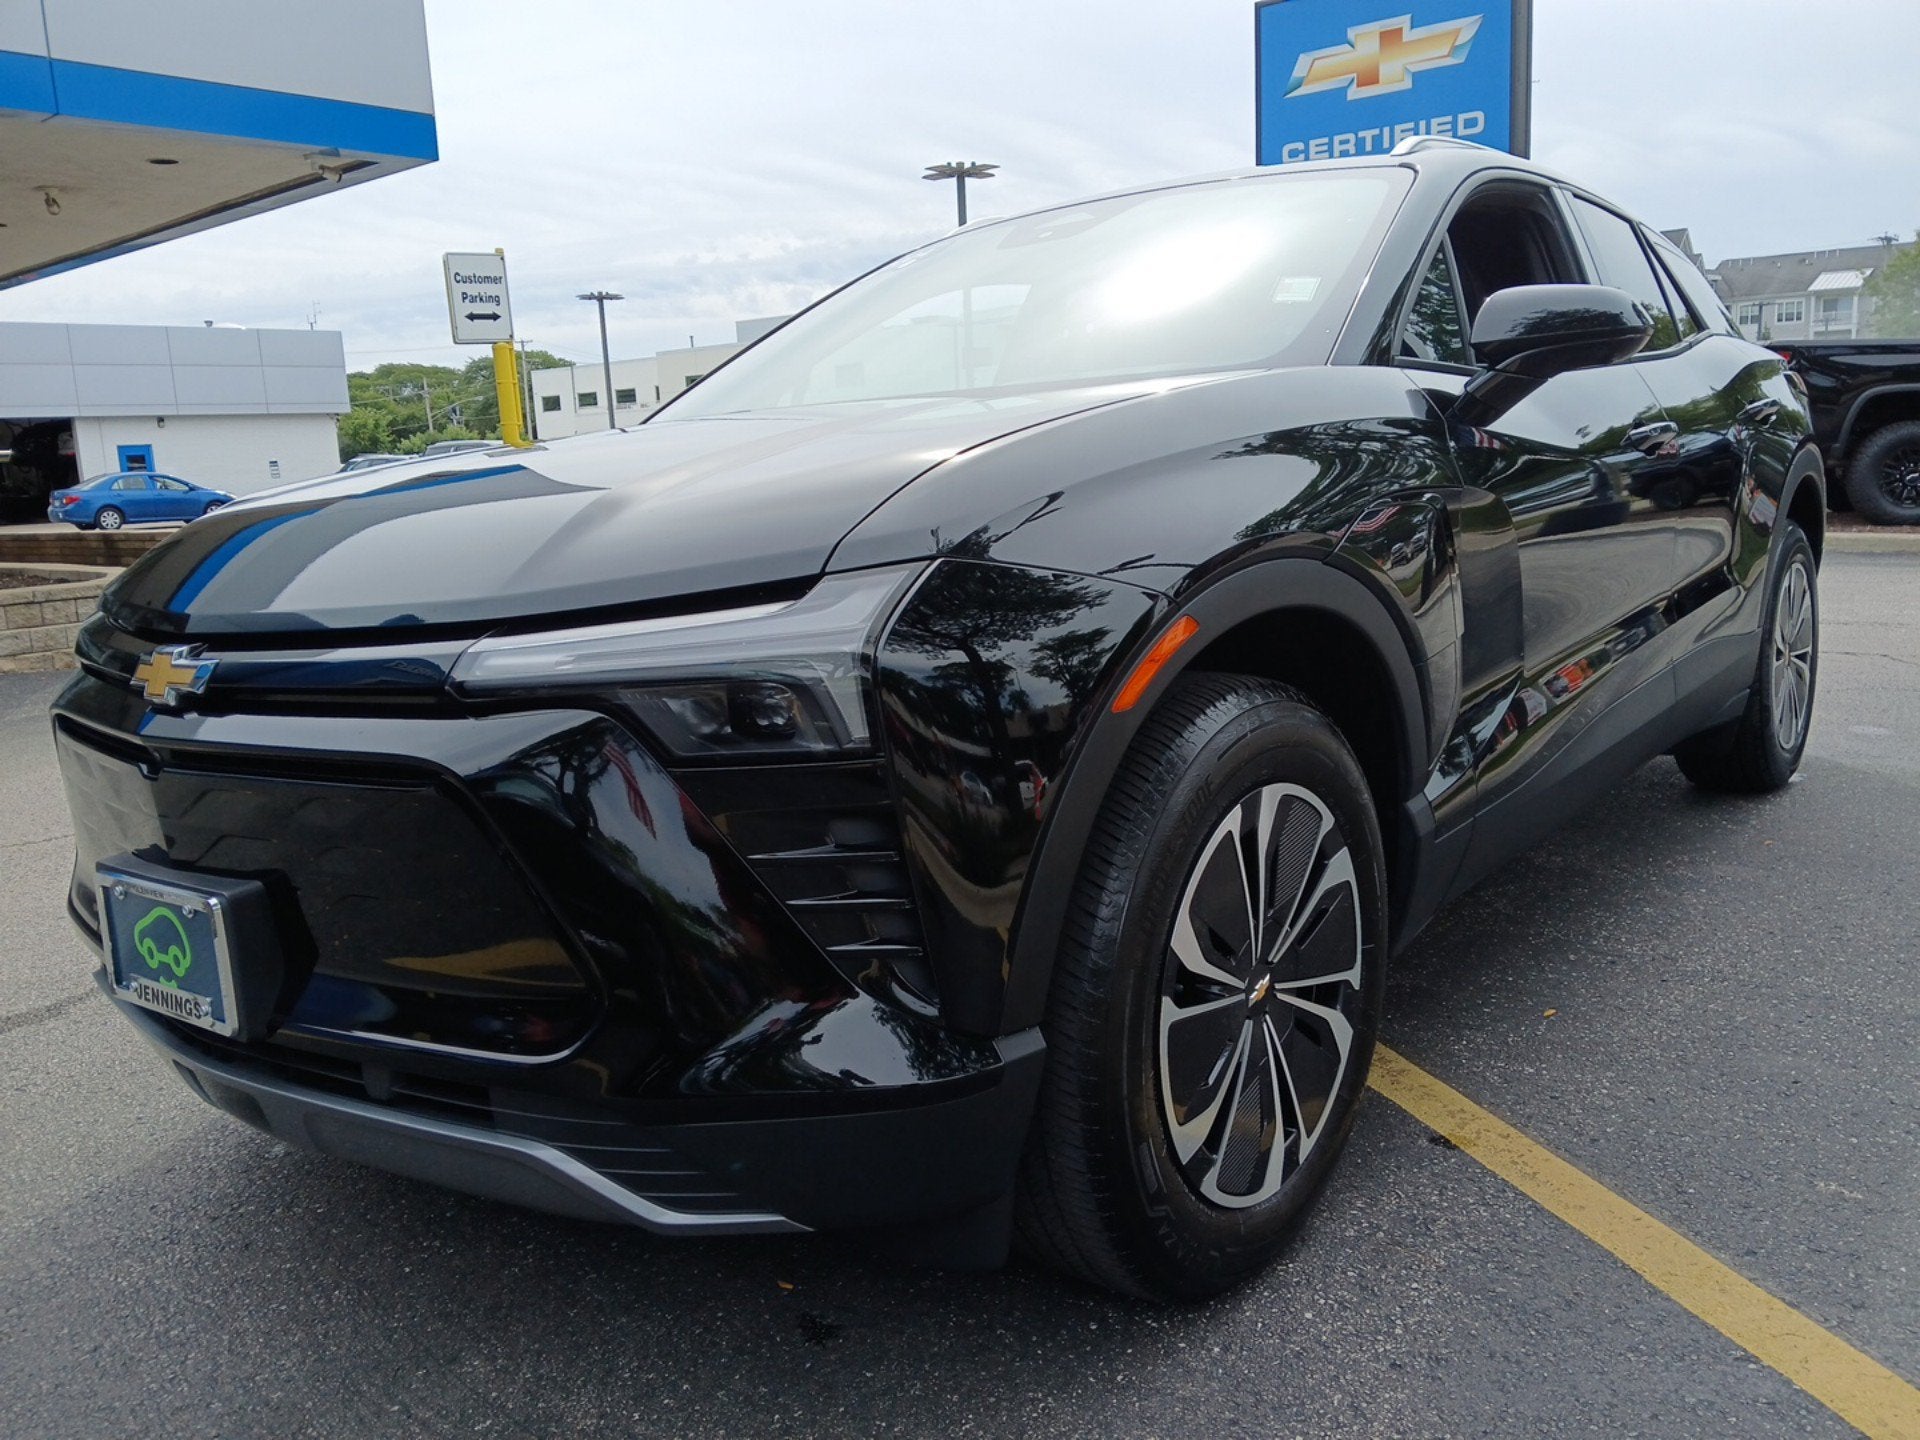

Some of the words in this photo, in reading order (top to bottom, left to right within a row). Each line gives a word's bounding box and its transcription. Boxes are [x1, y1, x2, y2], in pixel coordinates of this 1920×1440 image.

[1282, 111, 1484, 163] CERTIFIED
[454, 272, 503, 285] Customer
[461, 292, 501, 306] Parking
[136, 984, 202, 1019] JENNINGS
